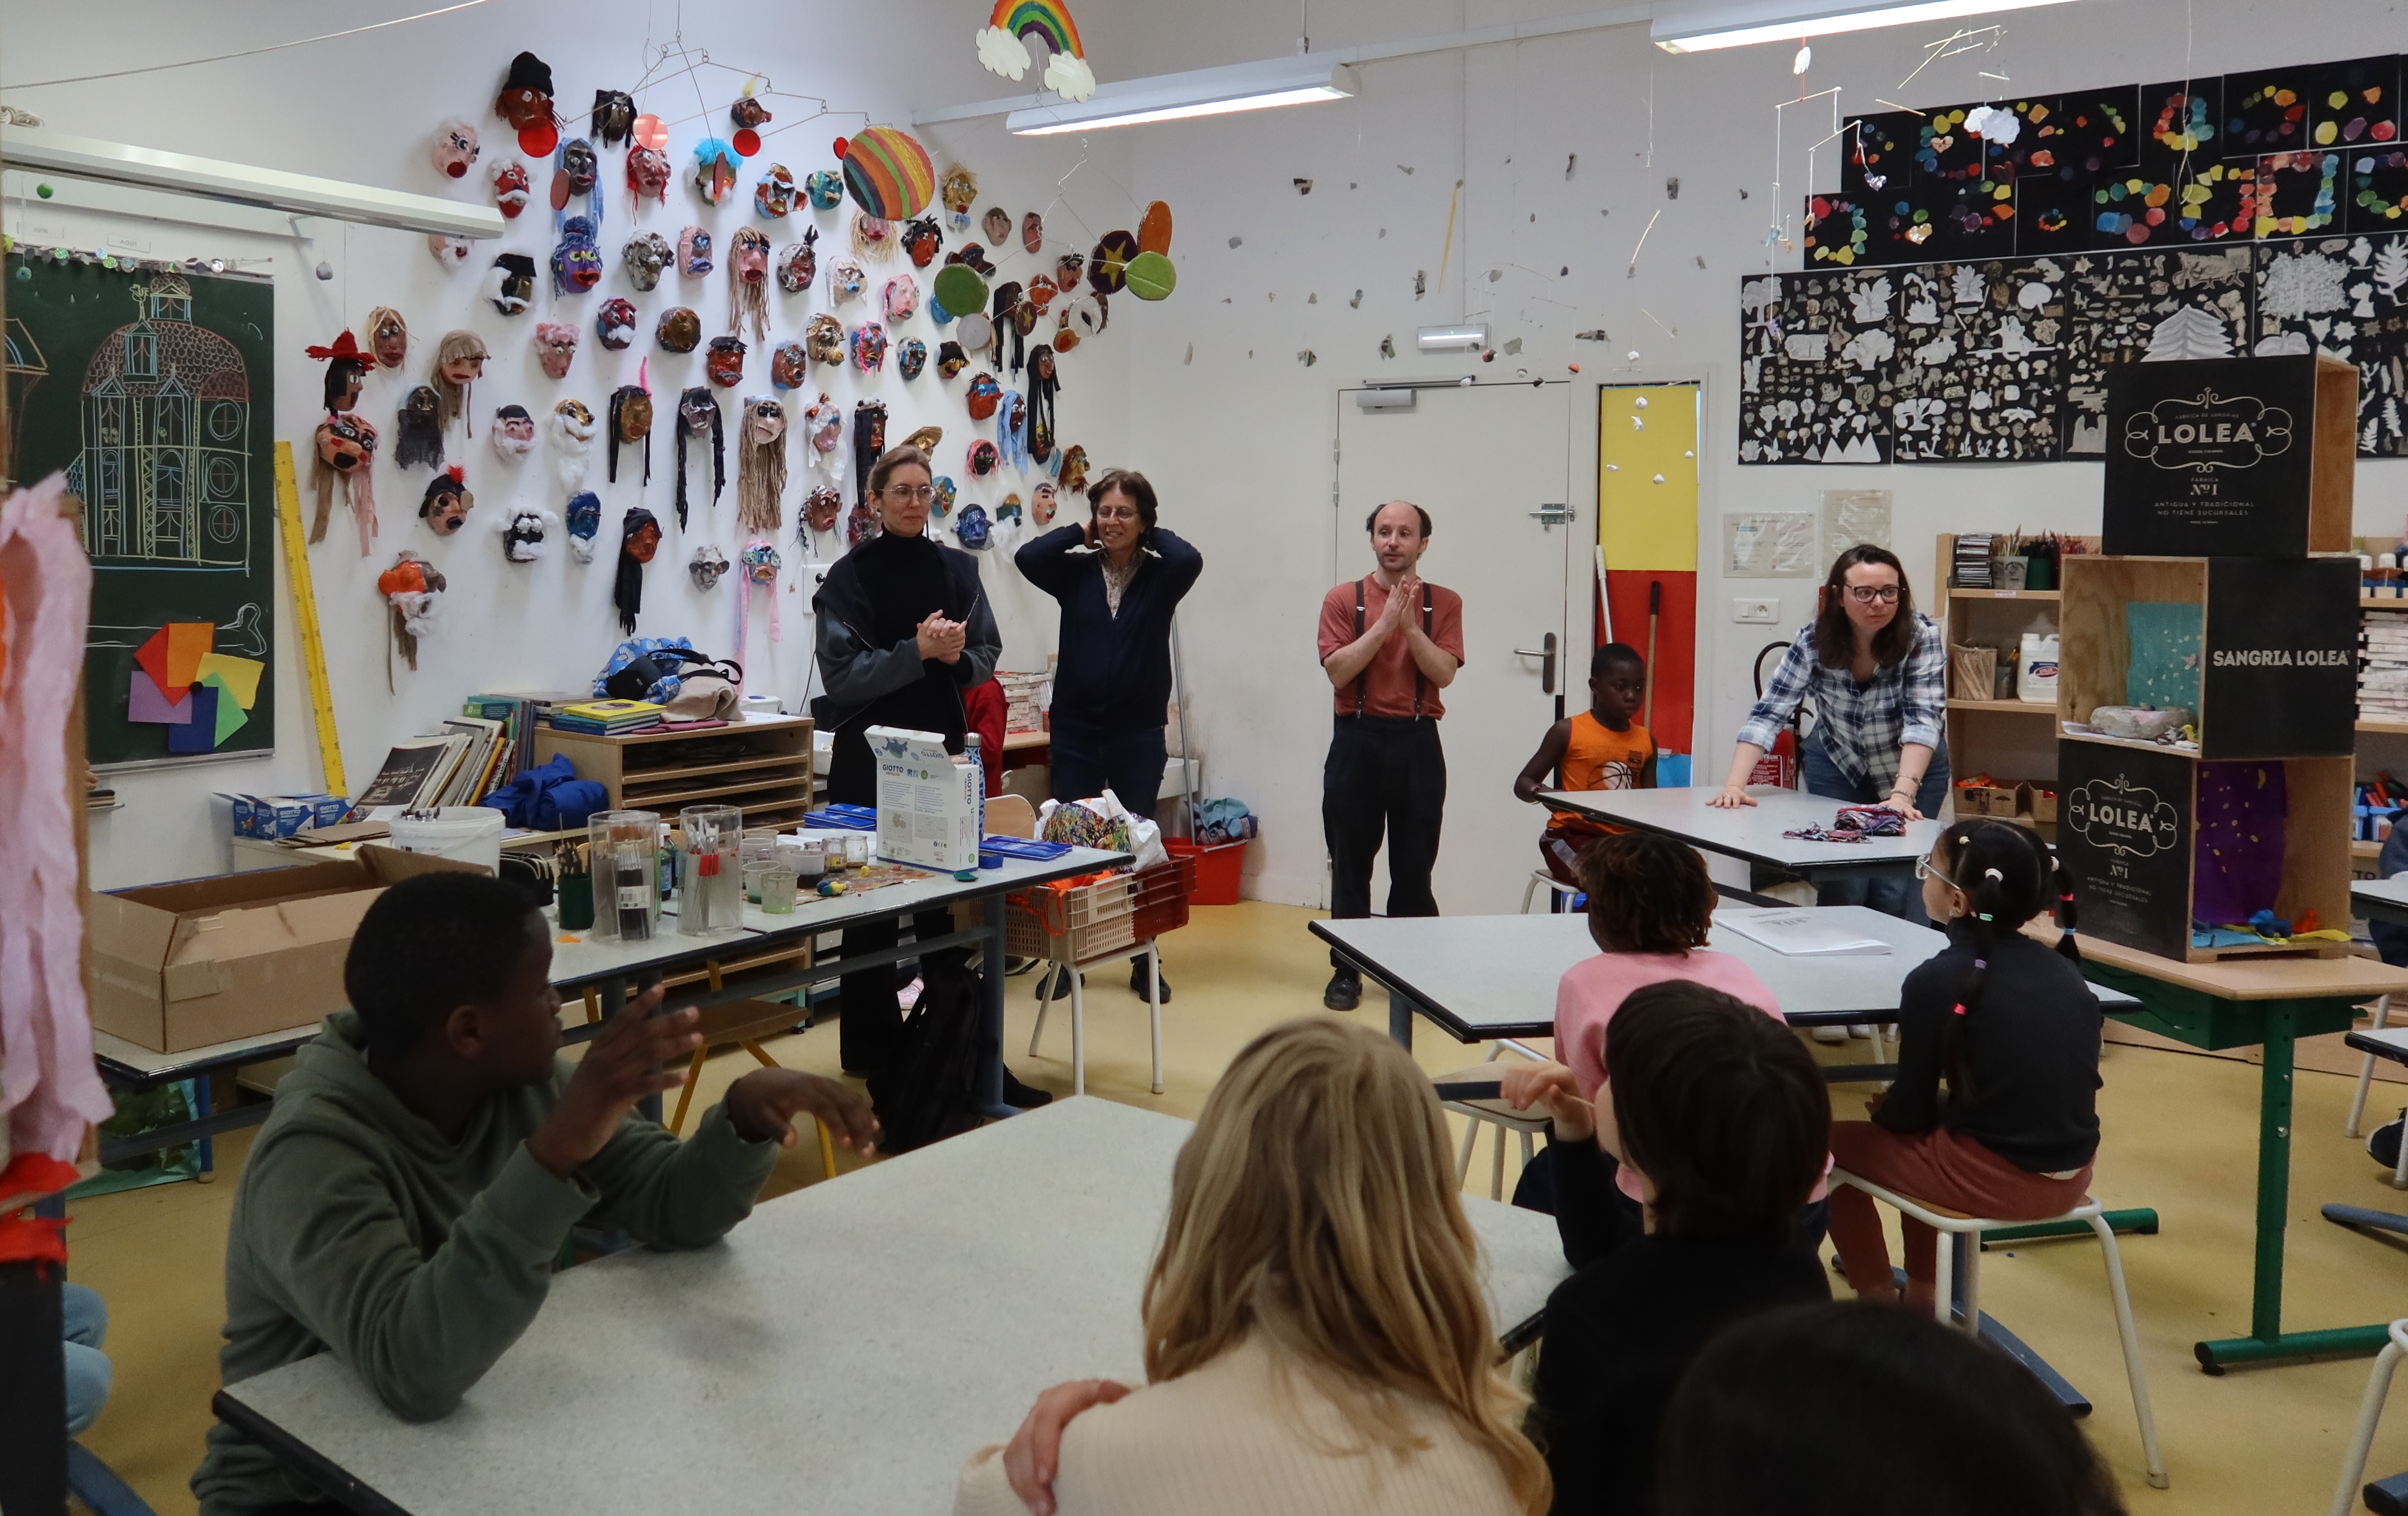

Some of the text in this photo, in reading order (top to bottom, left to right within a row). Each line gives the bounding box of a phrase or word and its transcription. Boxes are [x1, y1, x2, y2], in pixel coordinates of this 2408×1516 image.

[2158, 423, 2255, 444] LOLEA
[2213, 650, 2349, 666] SANGRIA LOLEA
[883, 764, 904, 773] GIOTTO
[2090, 803, 2153, 833] LOLEA
